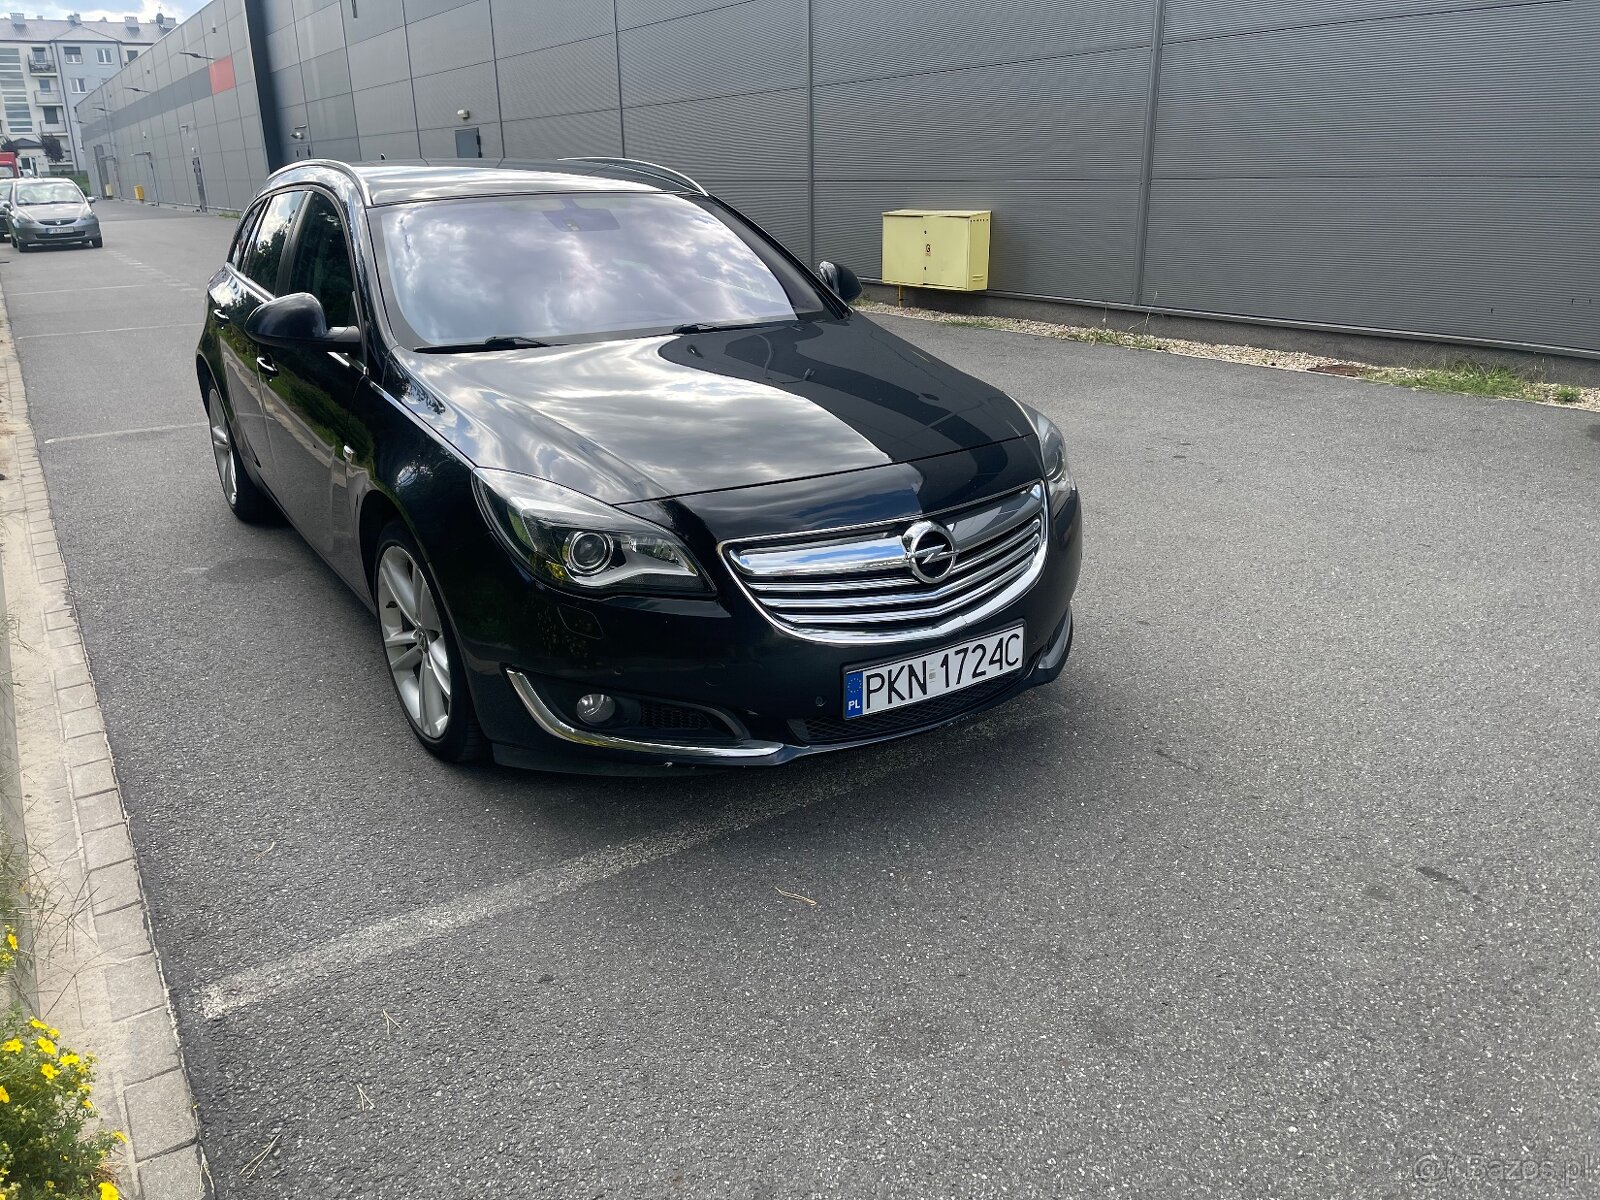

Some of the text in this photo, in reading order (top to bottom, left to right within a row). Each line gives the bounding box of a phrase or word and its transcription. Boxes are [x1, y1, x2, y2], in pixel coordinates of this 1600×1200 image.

[866, 634, 1020, 709] PKN 1724C
[848, 699, 861, 711] PL
